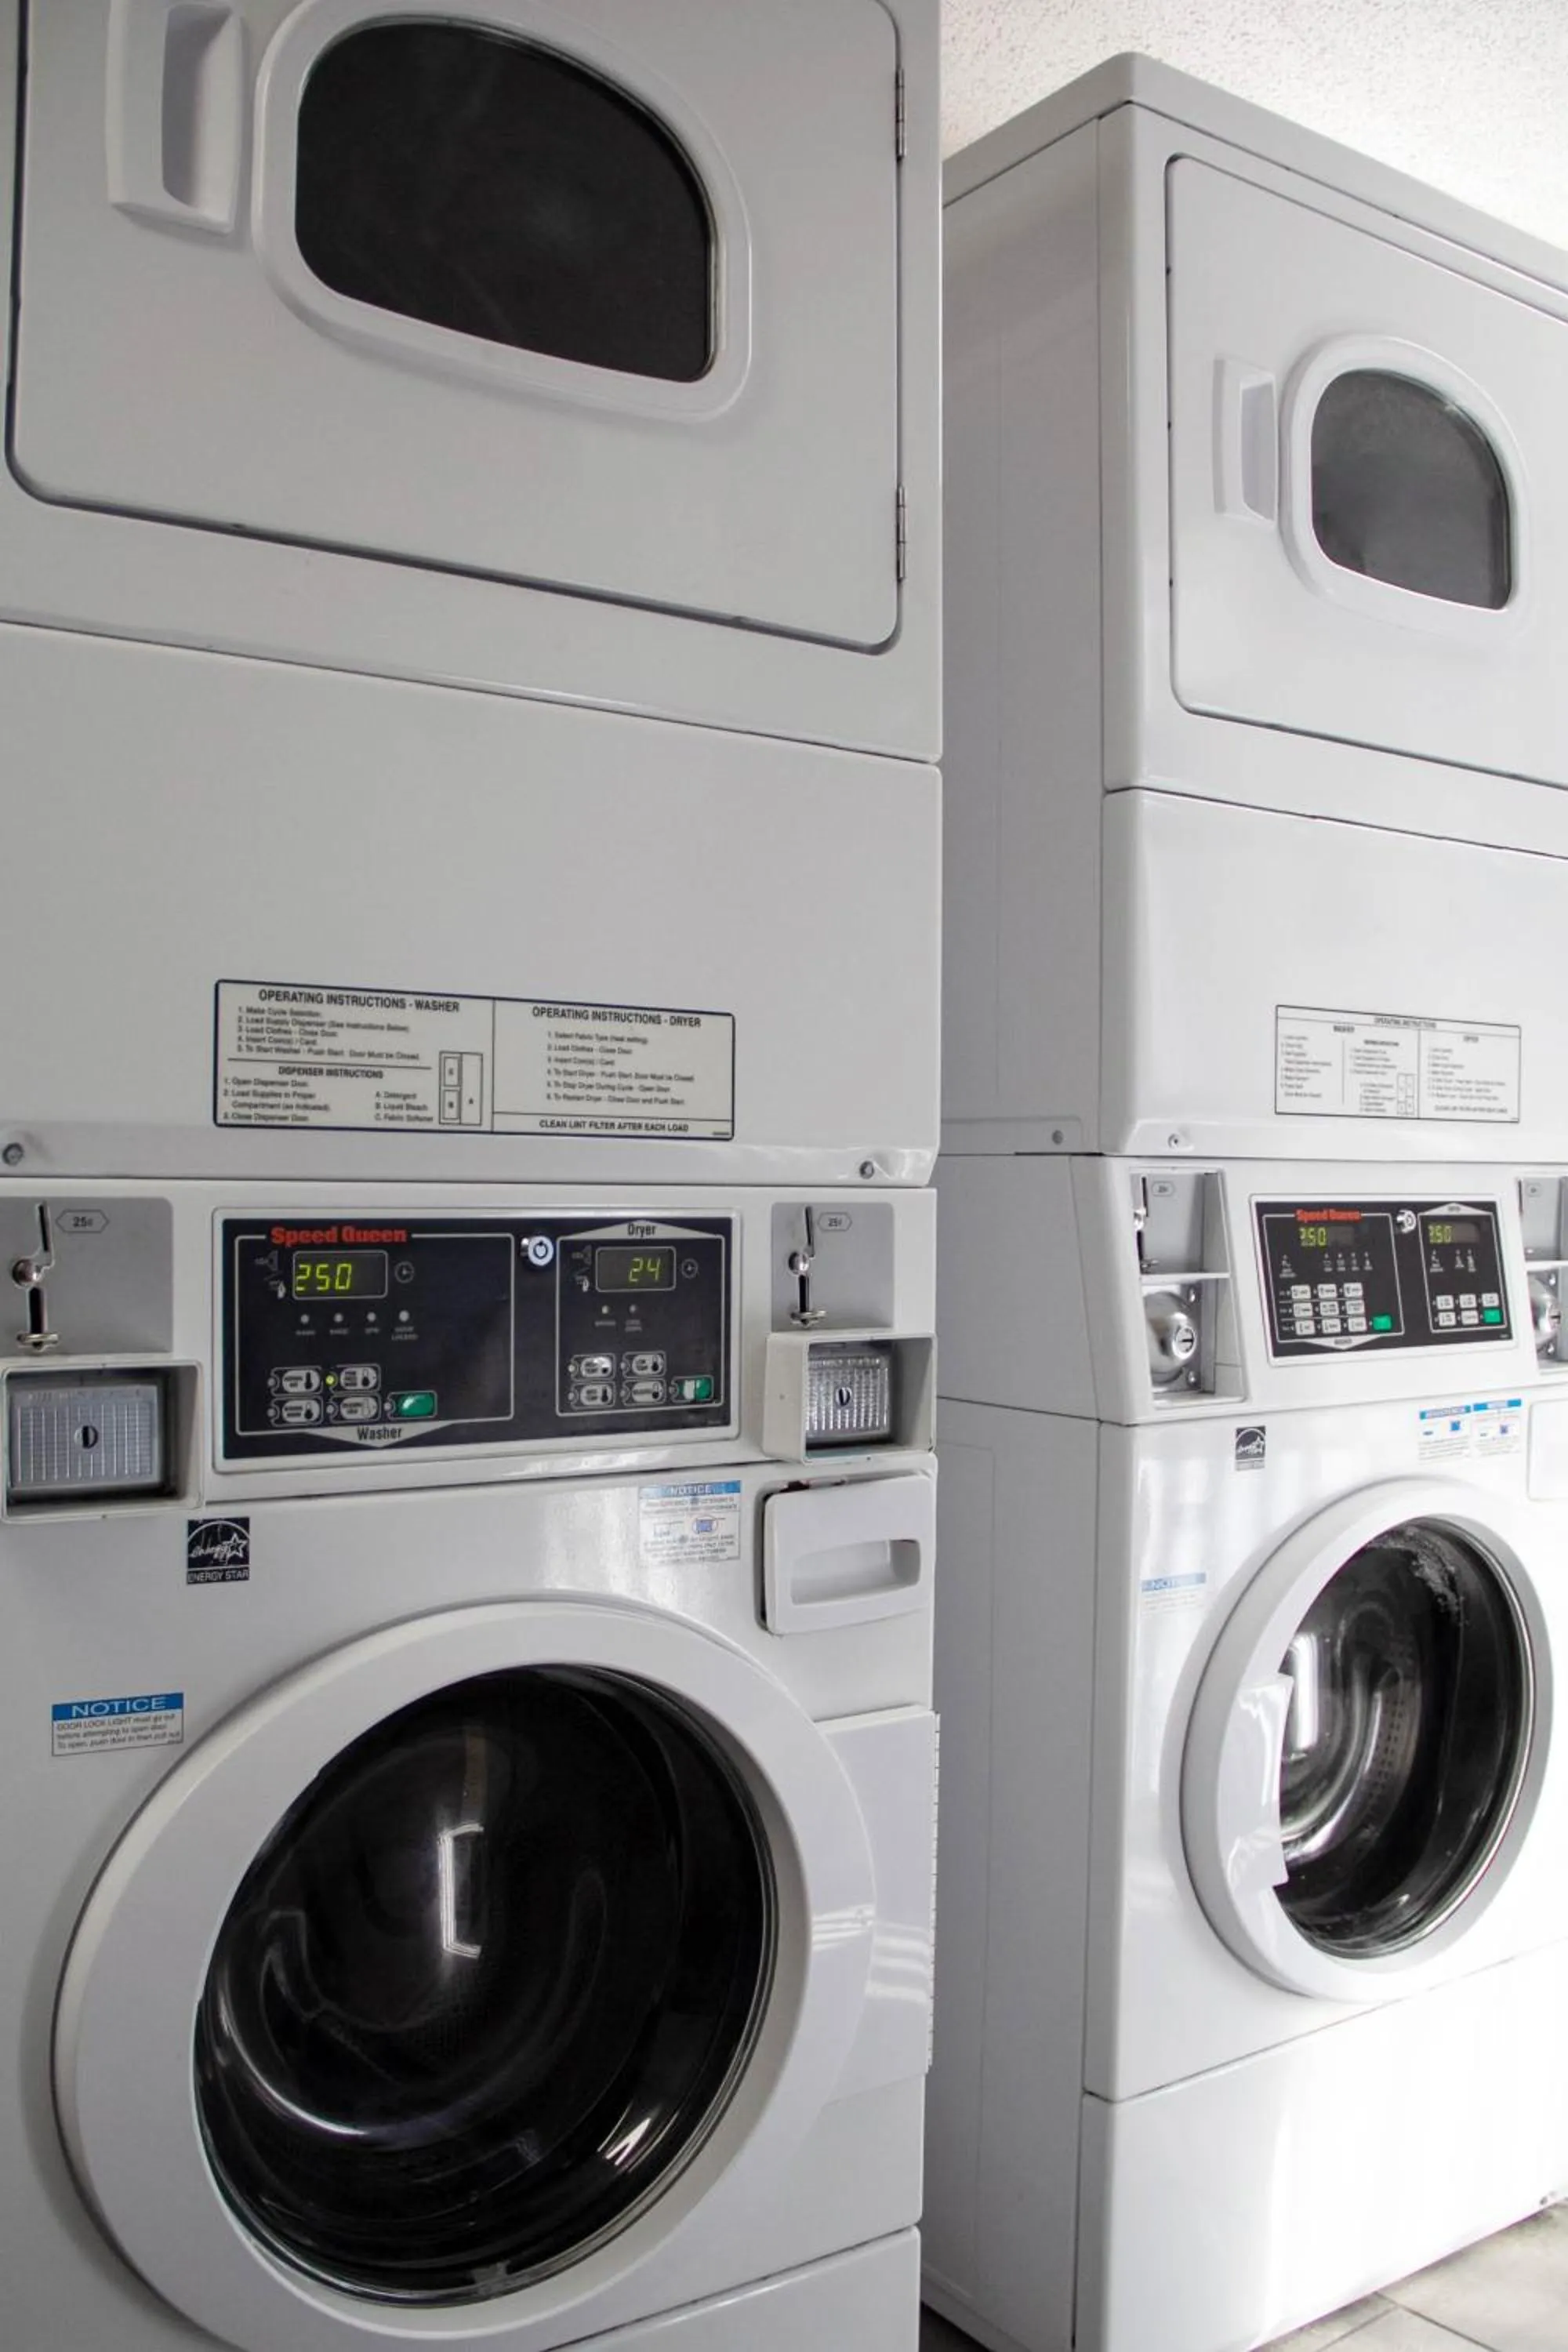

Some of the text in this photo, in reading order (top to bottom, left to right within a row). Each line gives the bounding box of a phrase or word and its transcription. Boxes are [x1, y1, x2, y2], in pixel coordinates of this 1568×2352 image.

[258, 988, 324, 1004] OPERATING
[327, 993, 406, 1009] INSTRUCTIONS
[415, 998, 460, 1012] WASHER
[532, 1006, 589, 1020] OPERATING
[591, 1010, 662, 1025] INSTRUCTIONS
[670, 1016, 702, 1027] DRYER
[278, 1065, 383, 1080] DISPENSER INSTRUCTIONS
[539, 1119, 690, 1134] CLEAN LINT FILTER AFTER EACH LOAD
[270, 1225, 408, 1247] Speed Queen
[628, 1223, 657, 1237] Dryer
[295, 1263, 353, 1291] 250
[629, 1258, 661, 1283] 24
[357, 1426, 402, 1441] Washer
[225, 1568, 249, 1580] STAR
[71, 1696, 167, 1718] NOTICE
